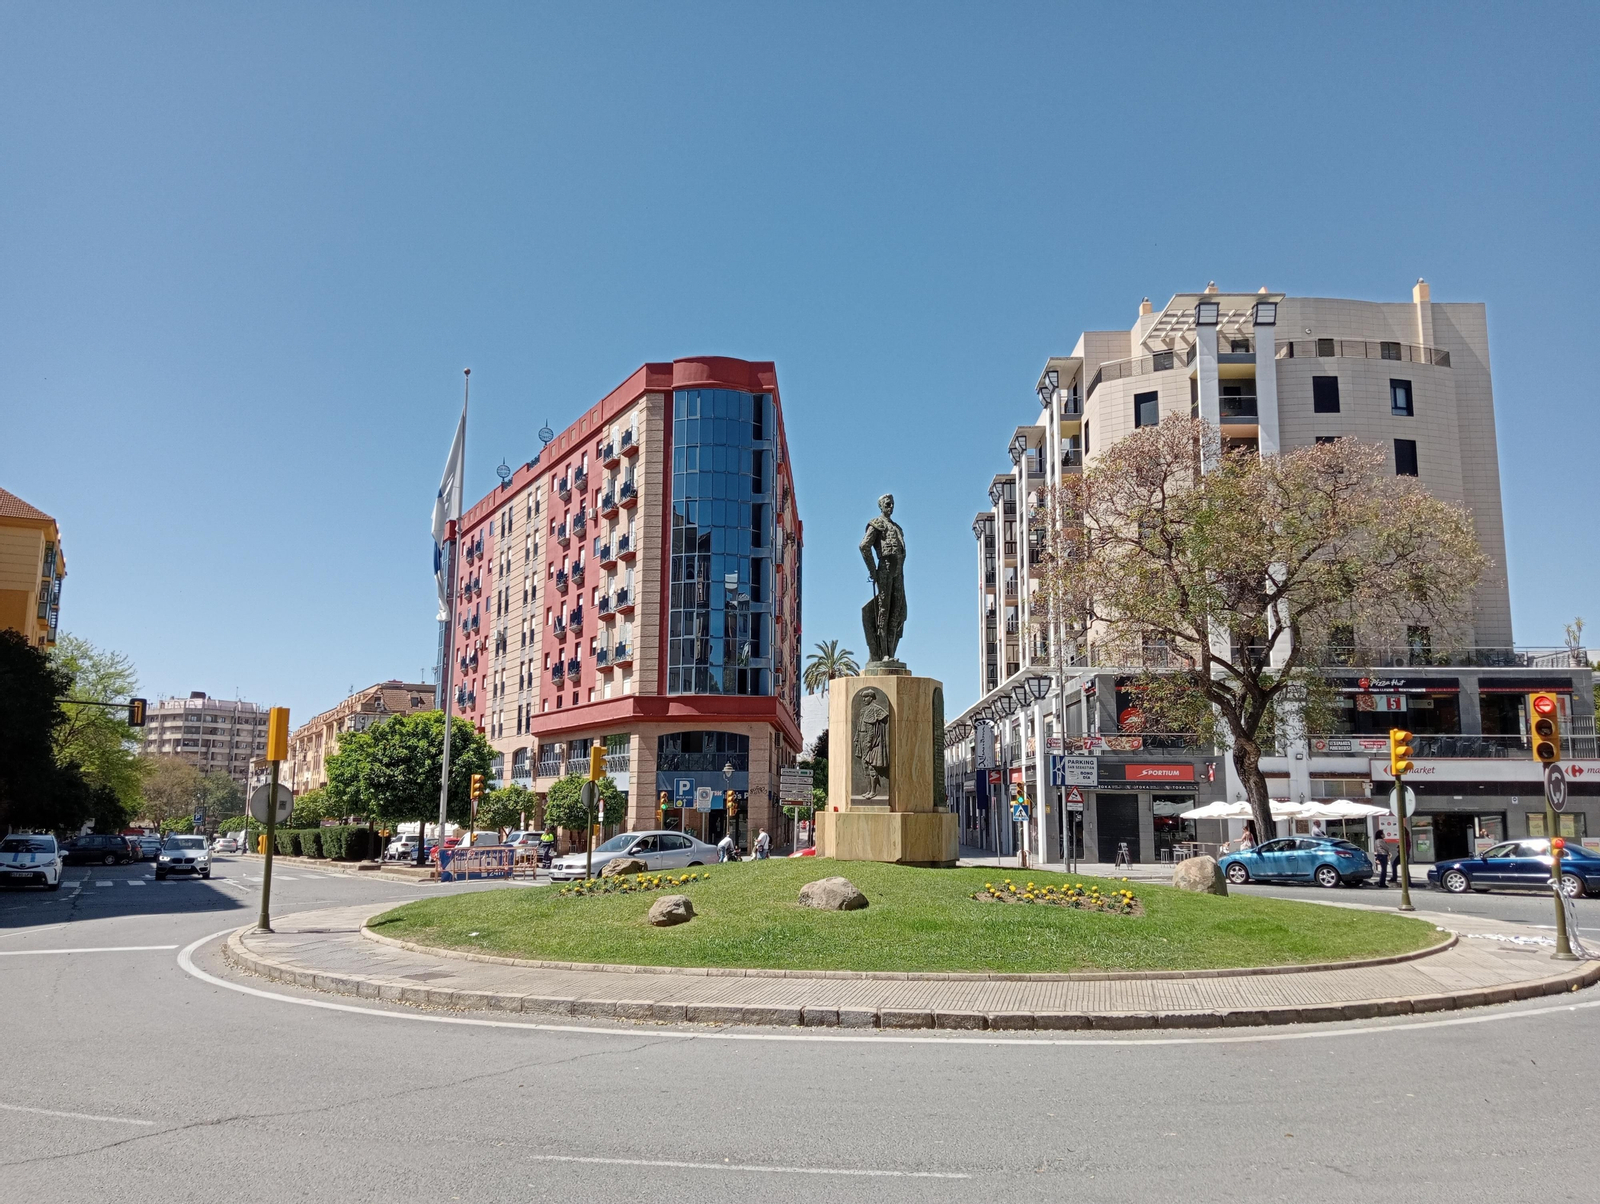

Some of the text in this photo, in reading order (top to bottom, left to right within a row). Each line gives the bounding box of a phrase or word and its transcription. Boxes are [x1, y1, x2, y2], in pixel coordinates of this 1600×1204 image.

[1370, 679, 1390, 687] Pizza
[1136, 767, 1180, 778] SPORTIUM
[679, 780, 691, 796] P
